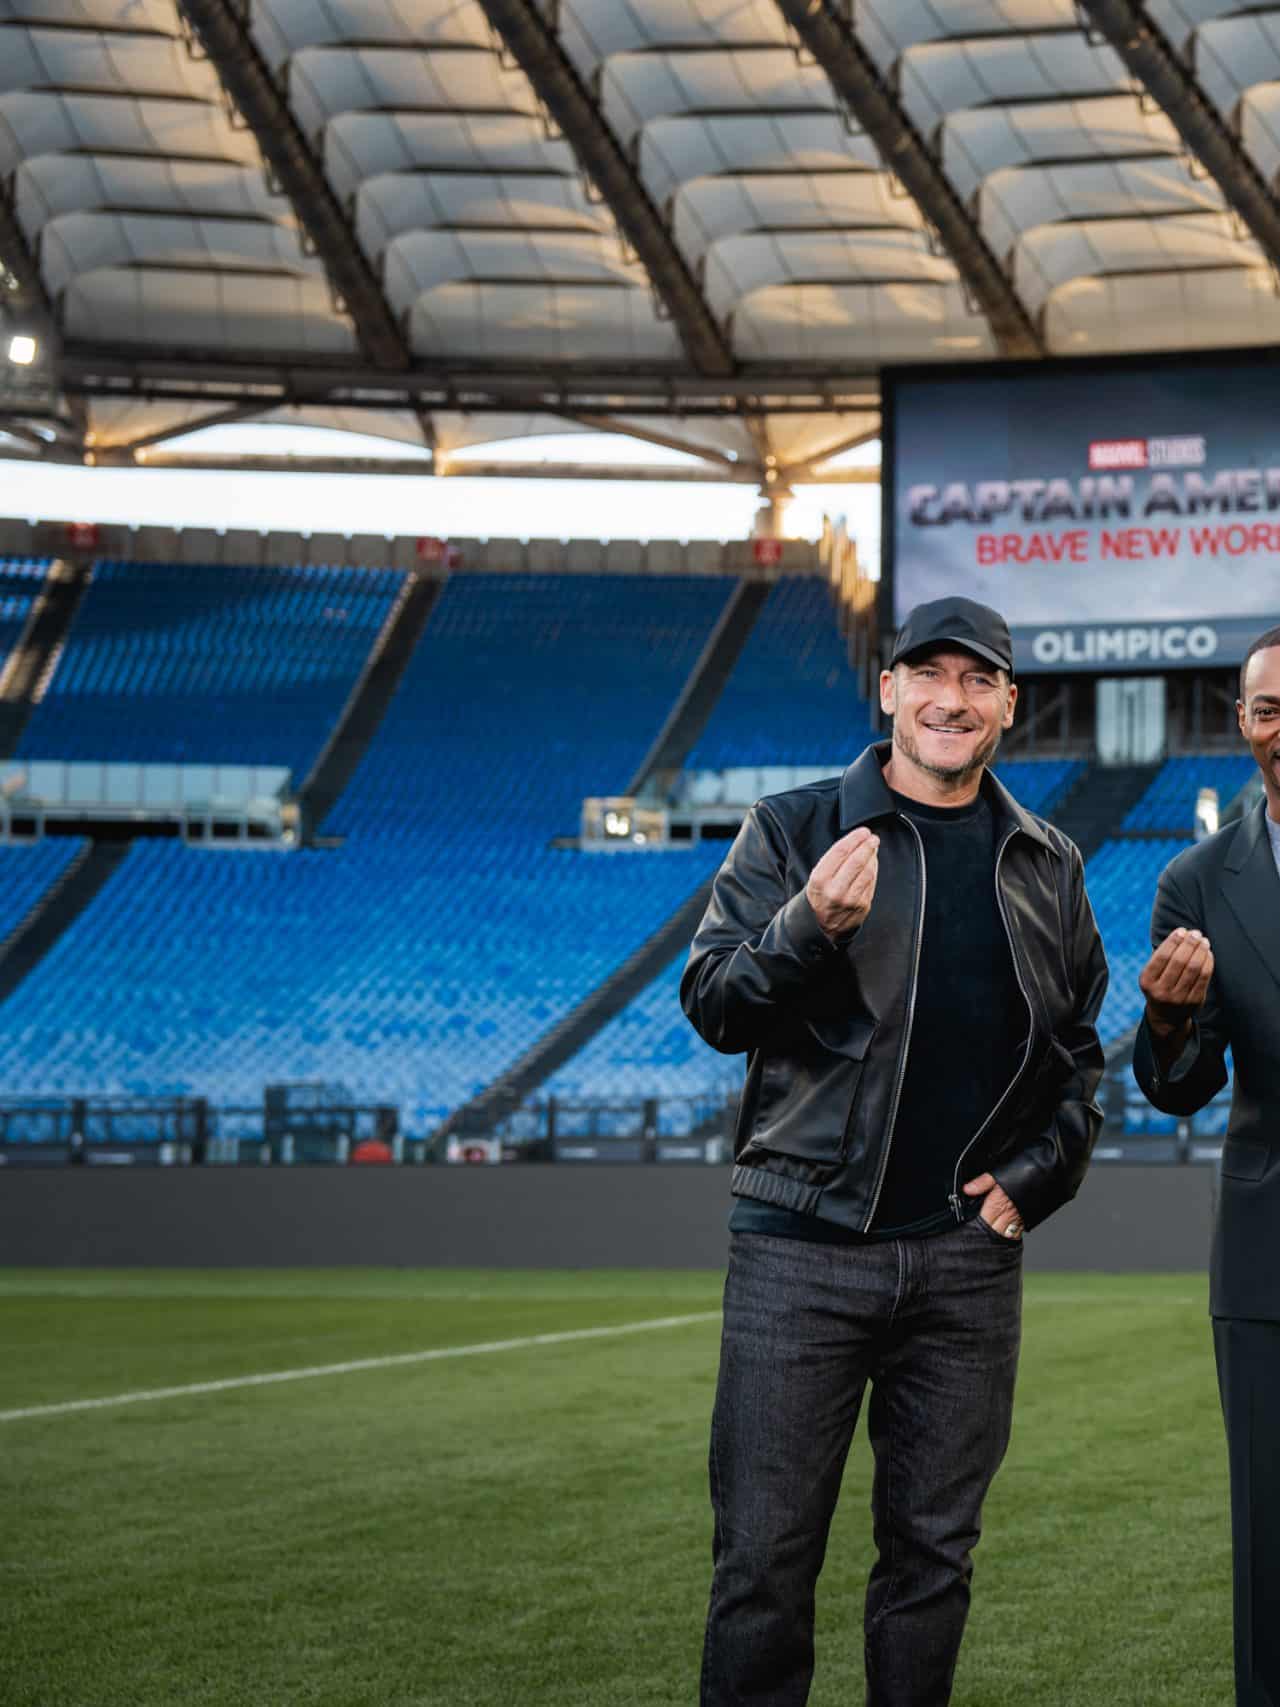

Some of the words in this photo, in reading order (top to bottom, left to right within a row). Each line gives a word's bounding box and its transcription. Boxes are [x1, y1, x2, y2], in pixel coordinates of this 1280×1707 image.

[908, 475, 1134, 525] CAPTAIN
[976, 530, 1090, 565] BRAVE
[1100, 527, 1180, 561] NEW
[1033, 626, 1217, 663] OLIMPICO
